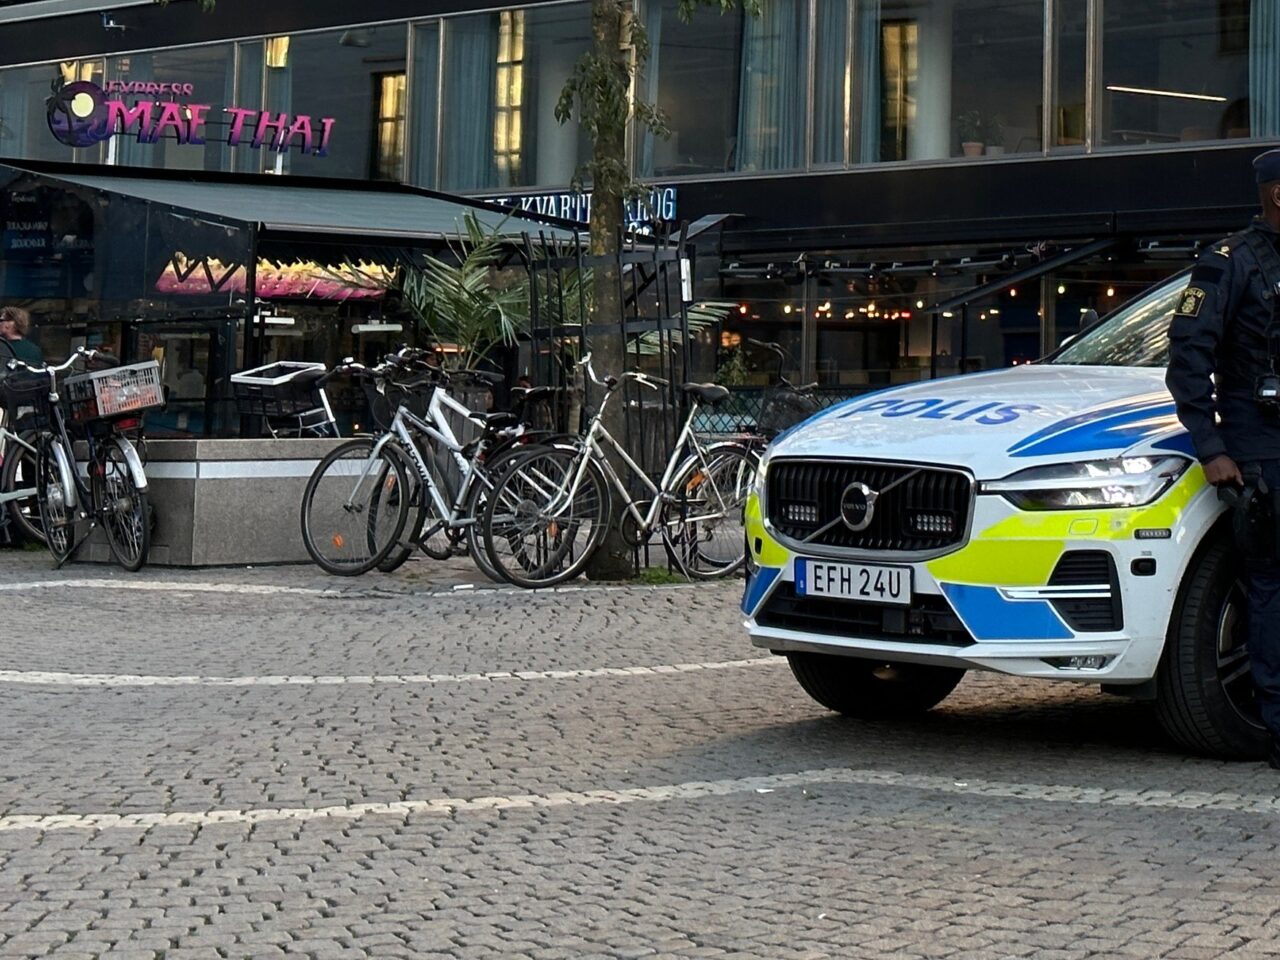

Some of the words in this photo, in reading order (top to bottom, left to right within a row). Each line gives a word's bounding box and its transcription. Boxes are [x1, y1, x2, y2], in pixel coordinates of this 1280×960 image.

[105, 80, 194, 95] EXPRESS
[224, 106, 336, 158] THAI
[837, 398, 1040, 425] POLIS
[814, 564, 851, 595] EFH
[859, 568, 901, 598] 24U
